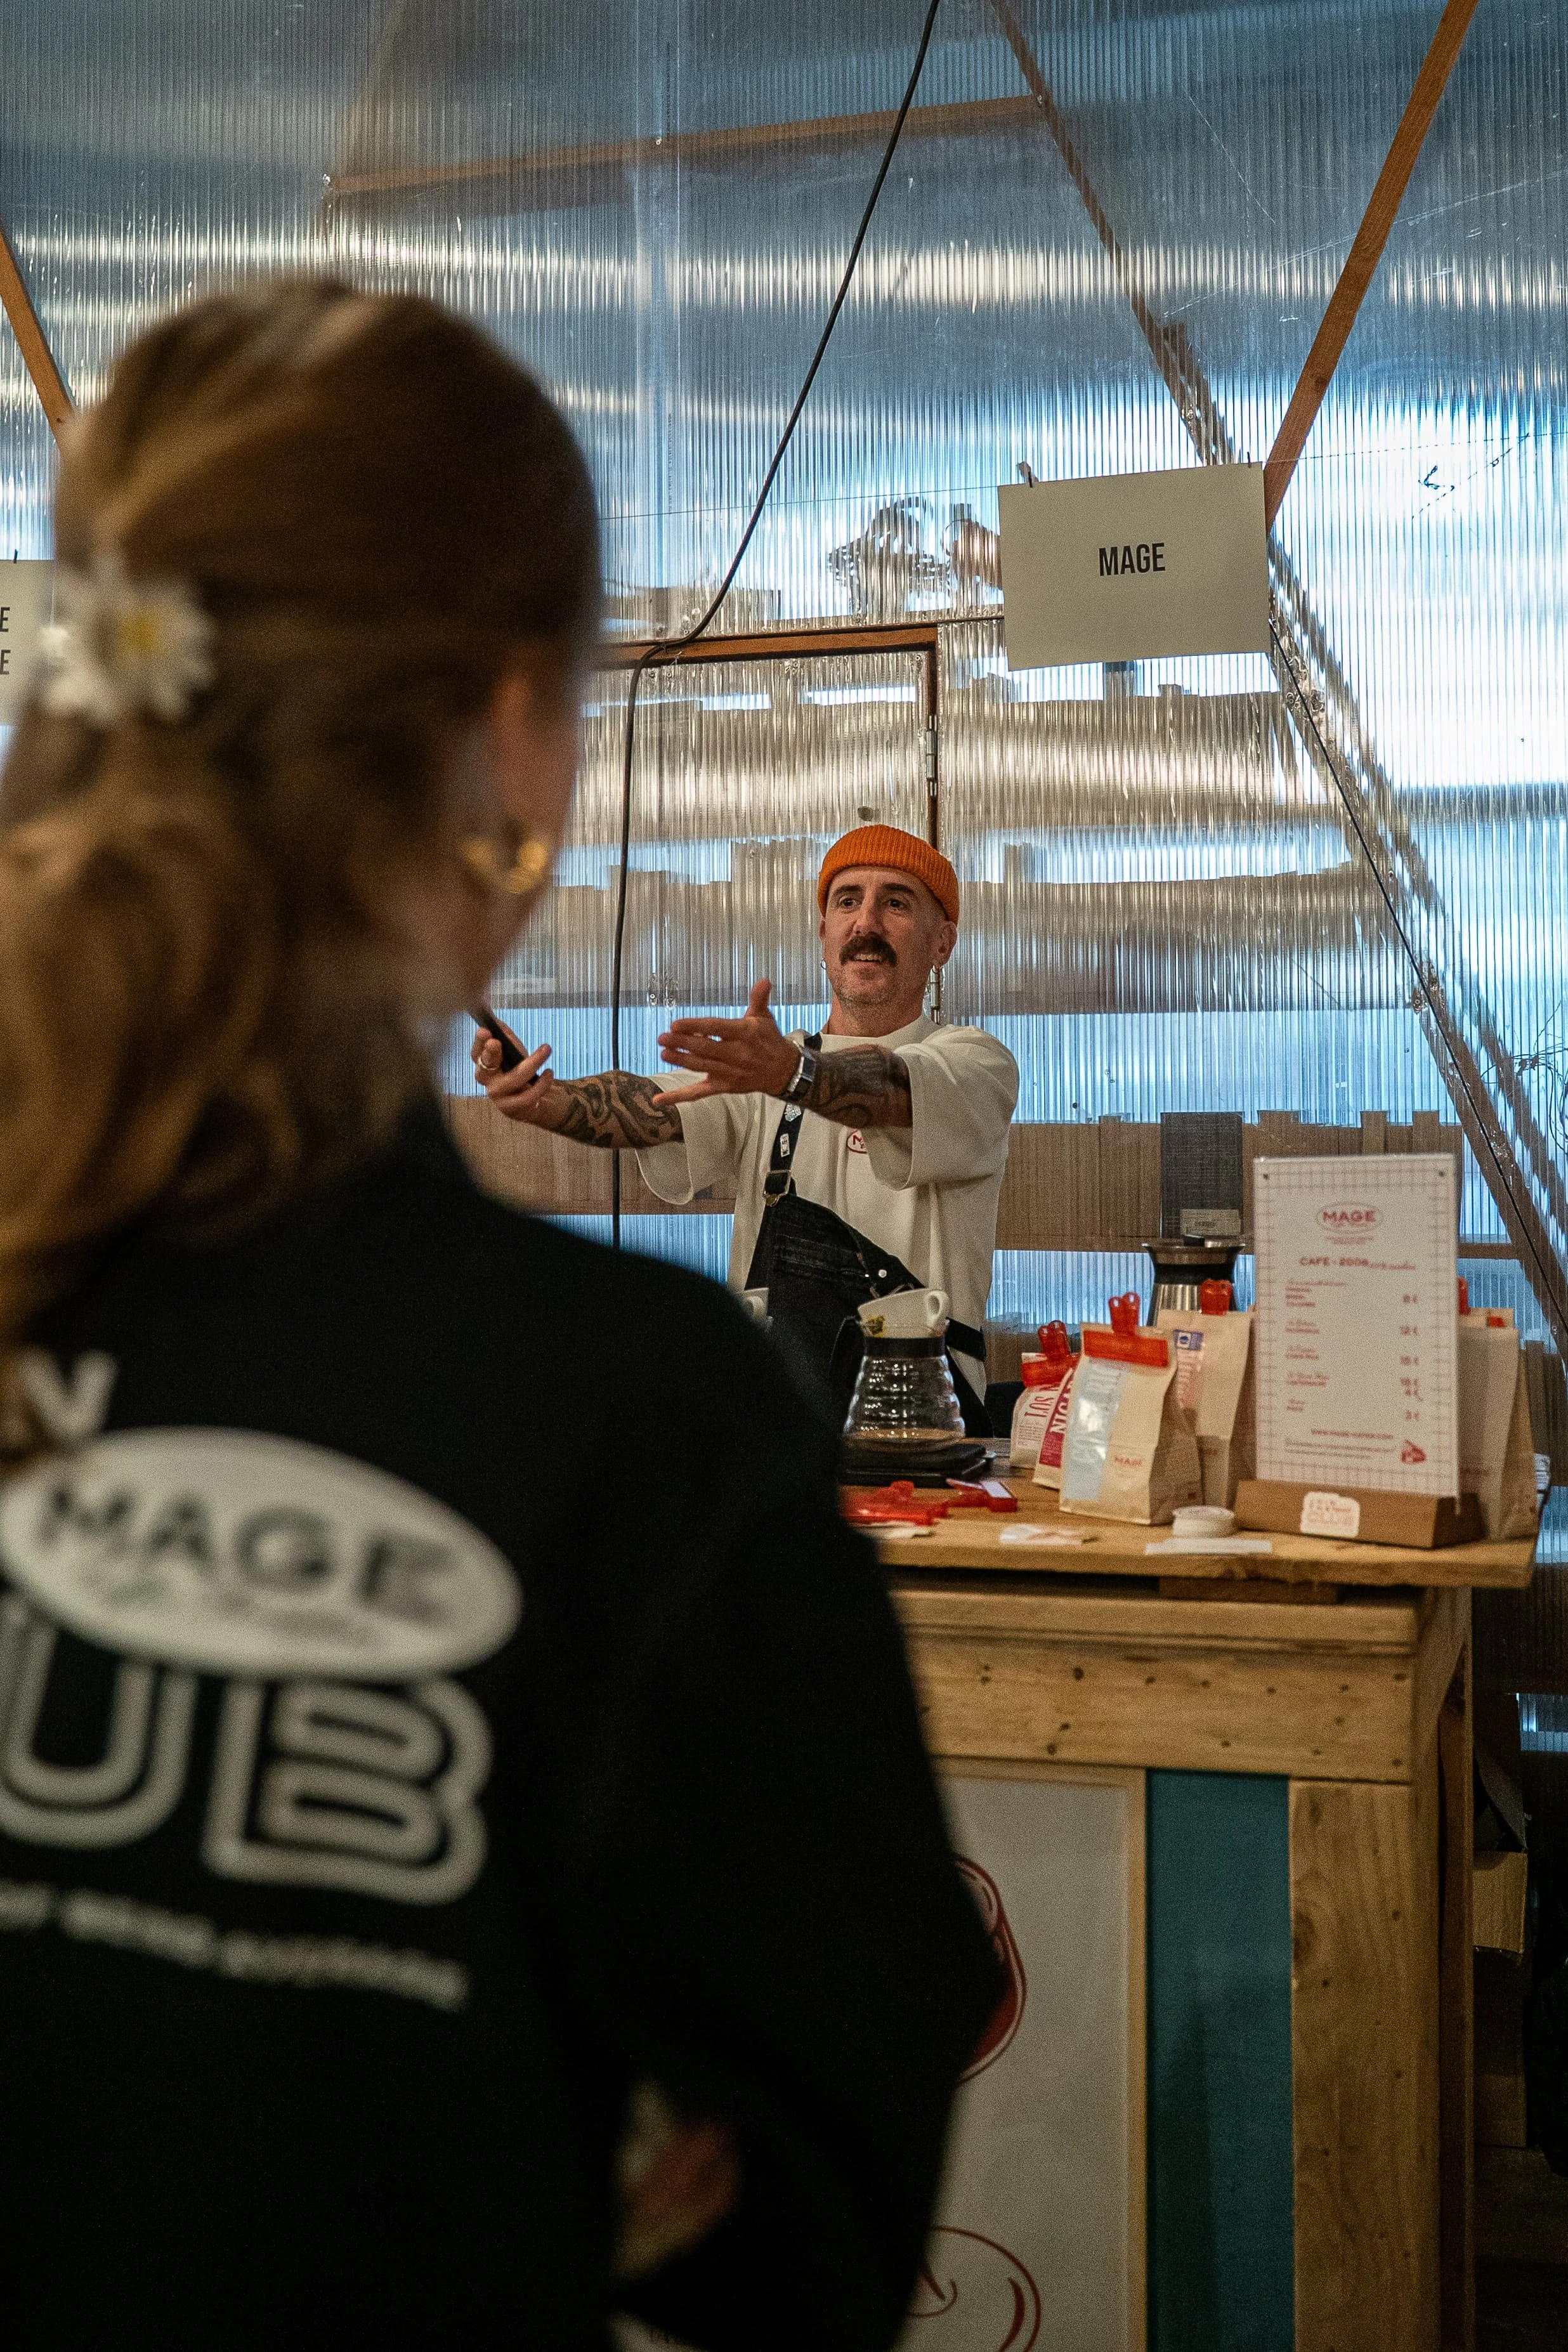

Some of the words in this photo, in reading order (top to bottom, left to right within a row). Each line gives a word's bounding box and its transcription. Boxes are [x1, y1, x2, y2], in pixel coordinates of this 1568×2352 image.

[1099, 542, 1166, 577] MAGE
[1323, 1210, 1376, 1223] MAGE
[38, 1482, 458, 1630] MAGE
